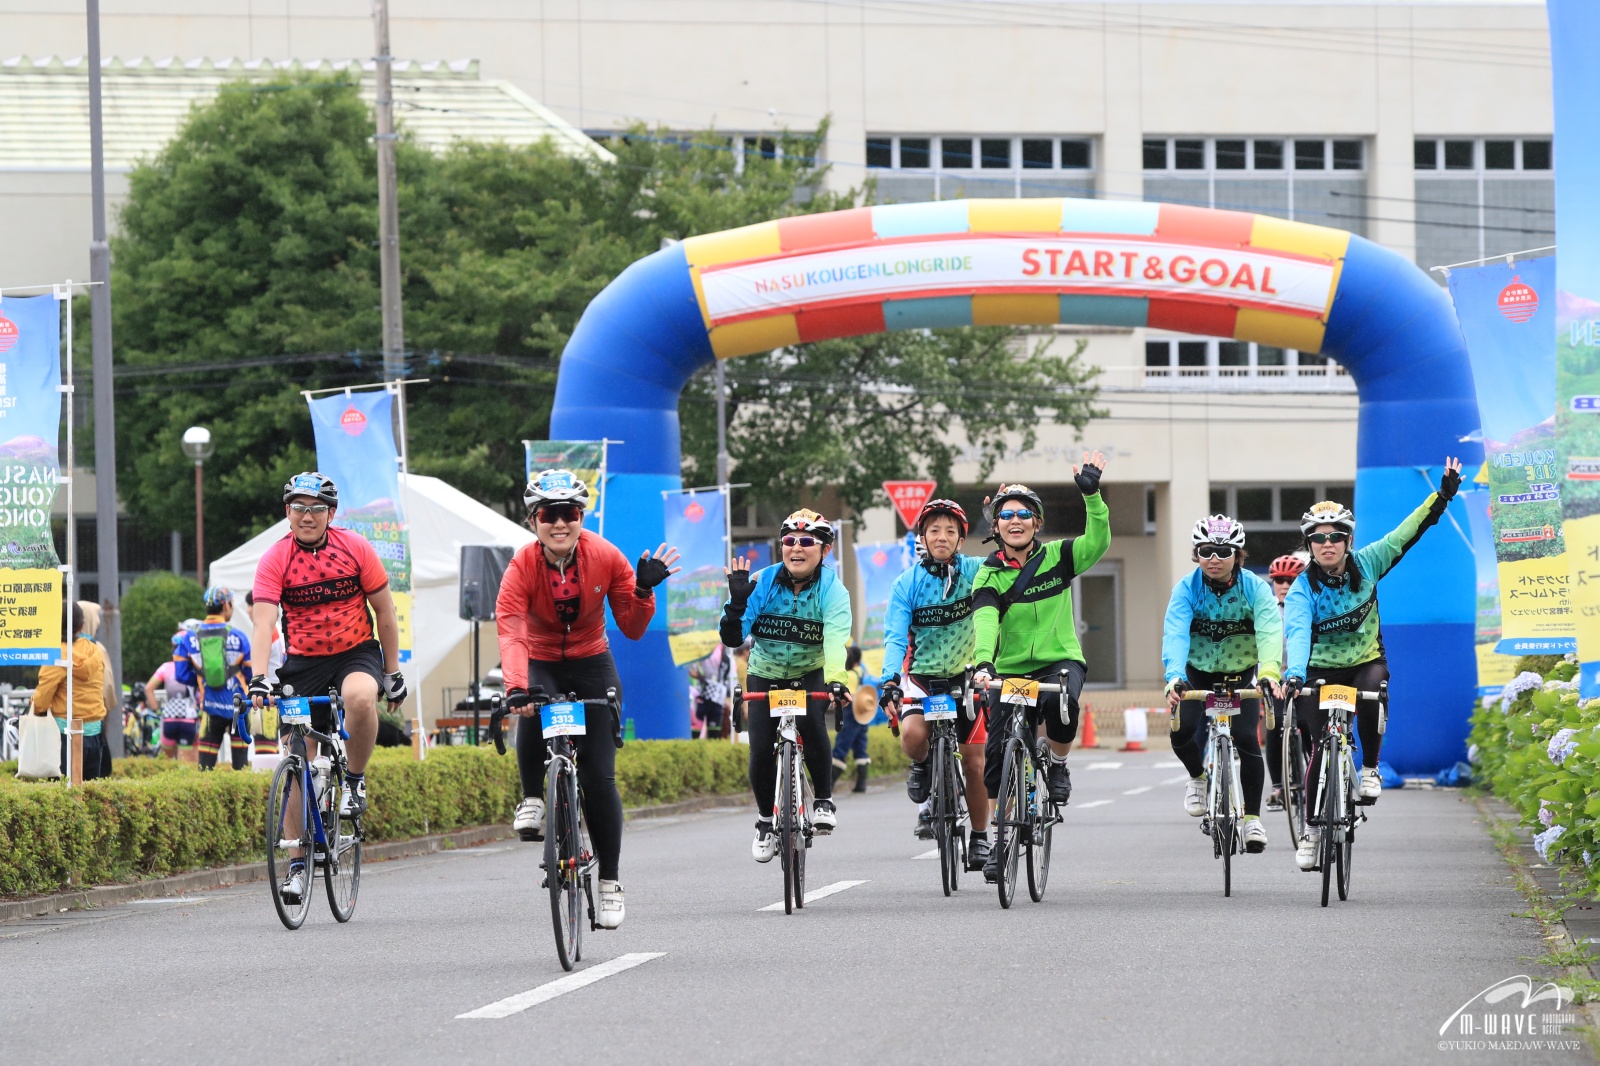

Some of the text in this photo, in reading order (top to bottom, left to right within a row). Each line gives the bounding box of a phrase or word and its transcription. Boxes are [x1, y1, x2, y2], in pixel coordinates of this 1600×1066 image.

[1022, 248, 1278, 294] START&GOAL
[546, 480, 568, 488] 3313
[894, 486, 926, 498] 止まれ
[900, 499, 922, 510] STOP
[286, 586, 322, 596] NANTO
[336, 580, 352, 588] SAI
[332, 586, 358, 598] TAKA
[950, 606, 972, 618] TAKA
[953, 602, 966, 610] SAI
[756, 618, 792, 628] NANTO
[804, 624, 820, 632] SAI
[1319, 616, 1350, 632] NANTO
[758, 626, 788, 636] NAKU
[551, 714, 574, 724] 3313
